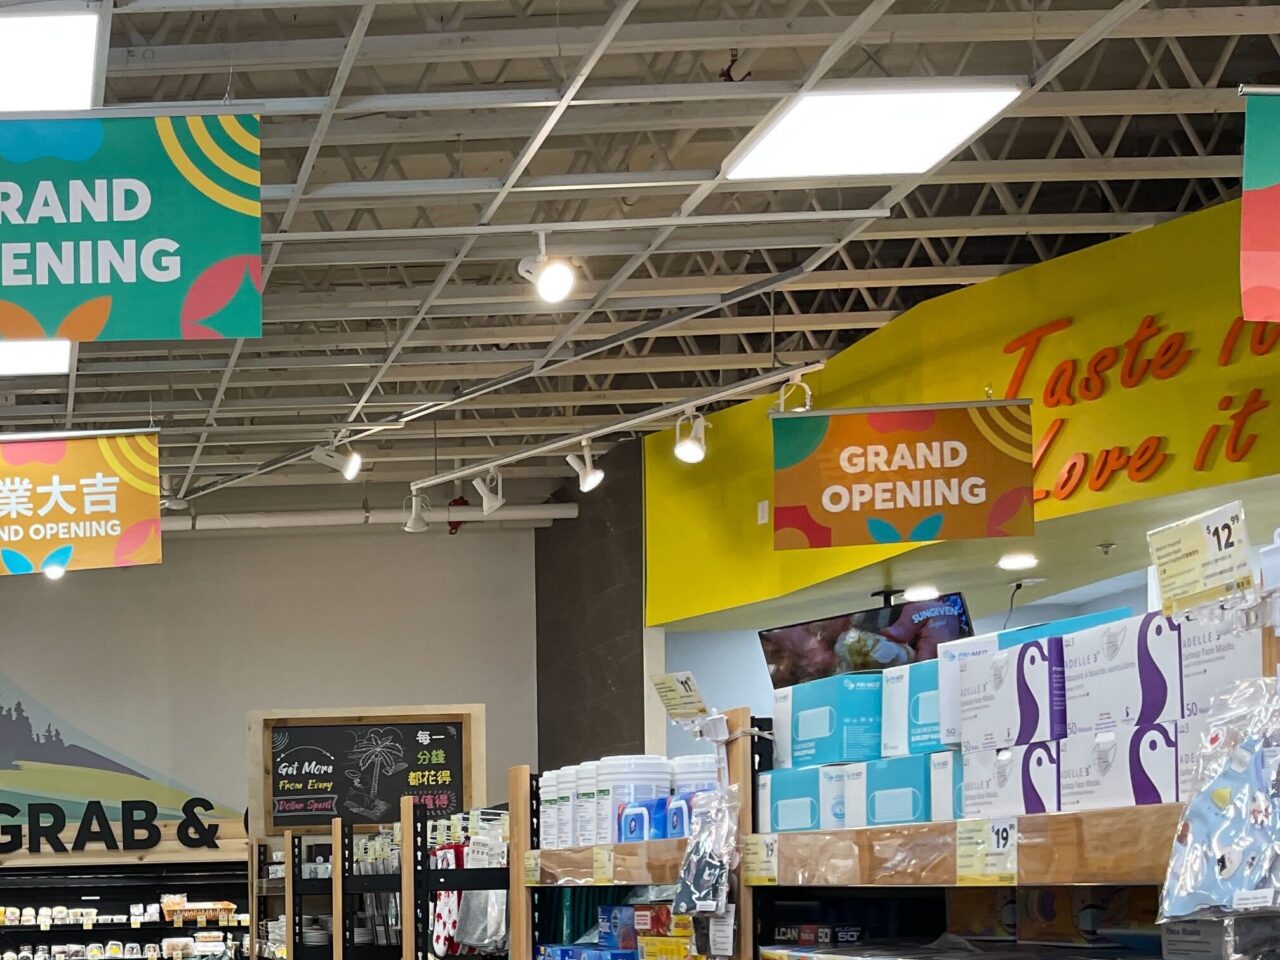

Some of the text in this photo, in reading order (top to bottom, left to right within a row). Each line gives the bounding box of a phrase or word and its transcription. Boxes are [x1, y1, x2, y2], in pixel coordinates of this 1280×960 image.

[1003, 315, 1191, 408] Taste
[1193, 388, 1268, 472] it
[839, 440, 968, 474] GRAND
[821, 477, 986, 513] OPENING
[29, 520, 121, 540] OPENING
[911, 606, 959, 624] SUNGIVEN
[1186, 702, 1198, 717] 50
[416, 730, 445, 745] 每一
[278, 760, 333, 775] Get More
[279, 779, 333, 791] From Every
[408, 770, 452, 786] 都花得
[278, 800, 304, 810] Dollar
[176, 797, 220, 850] &
